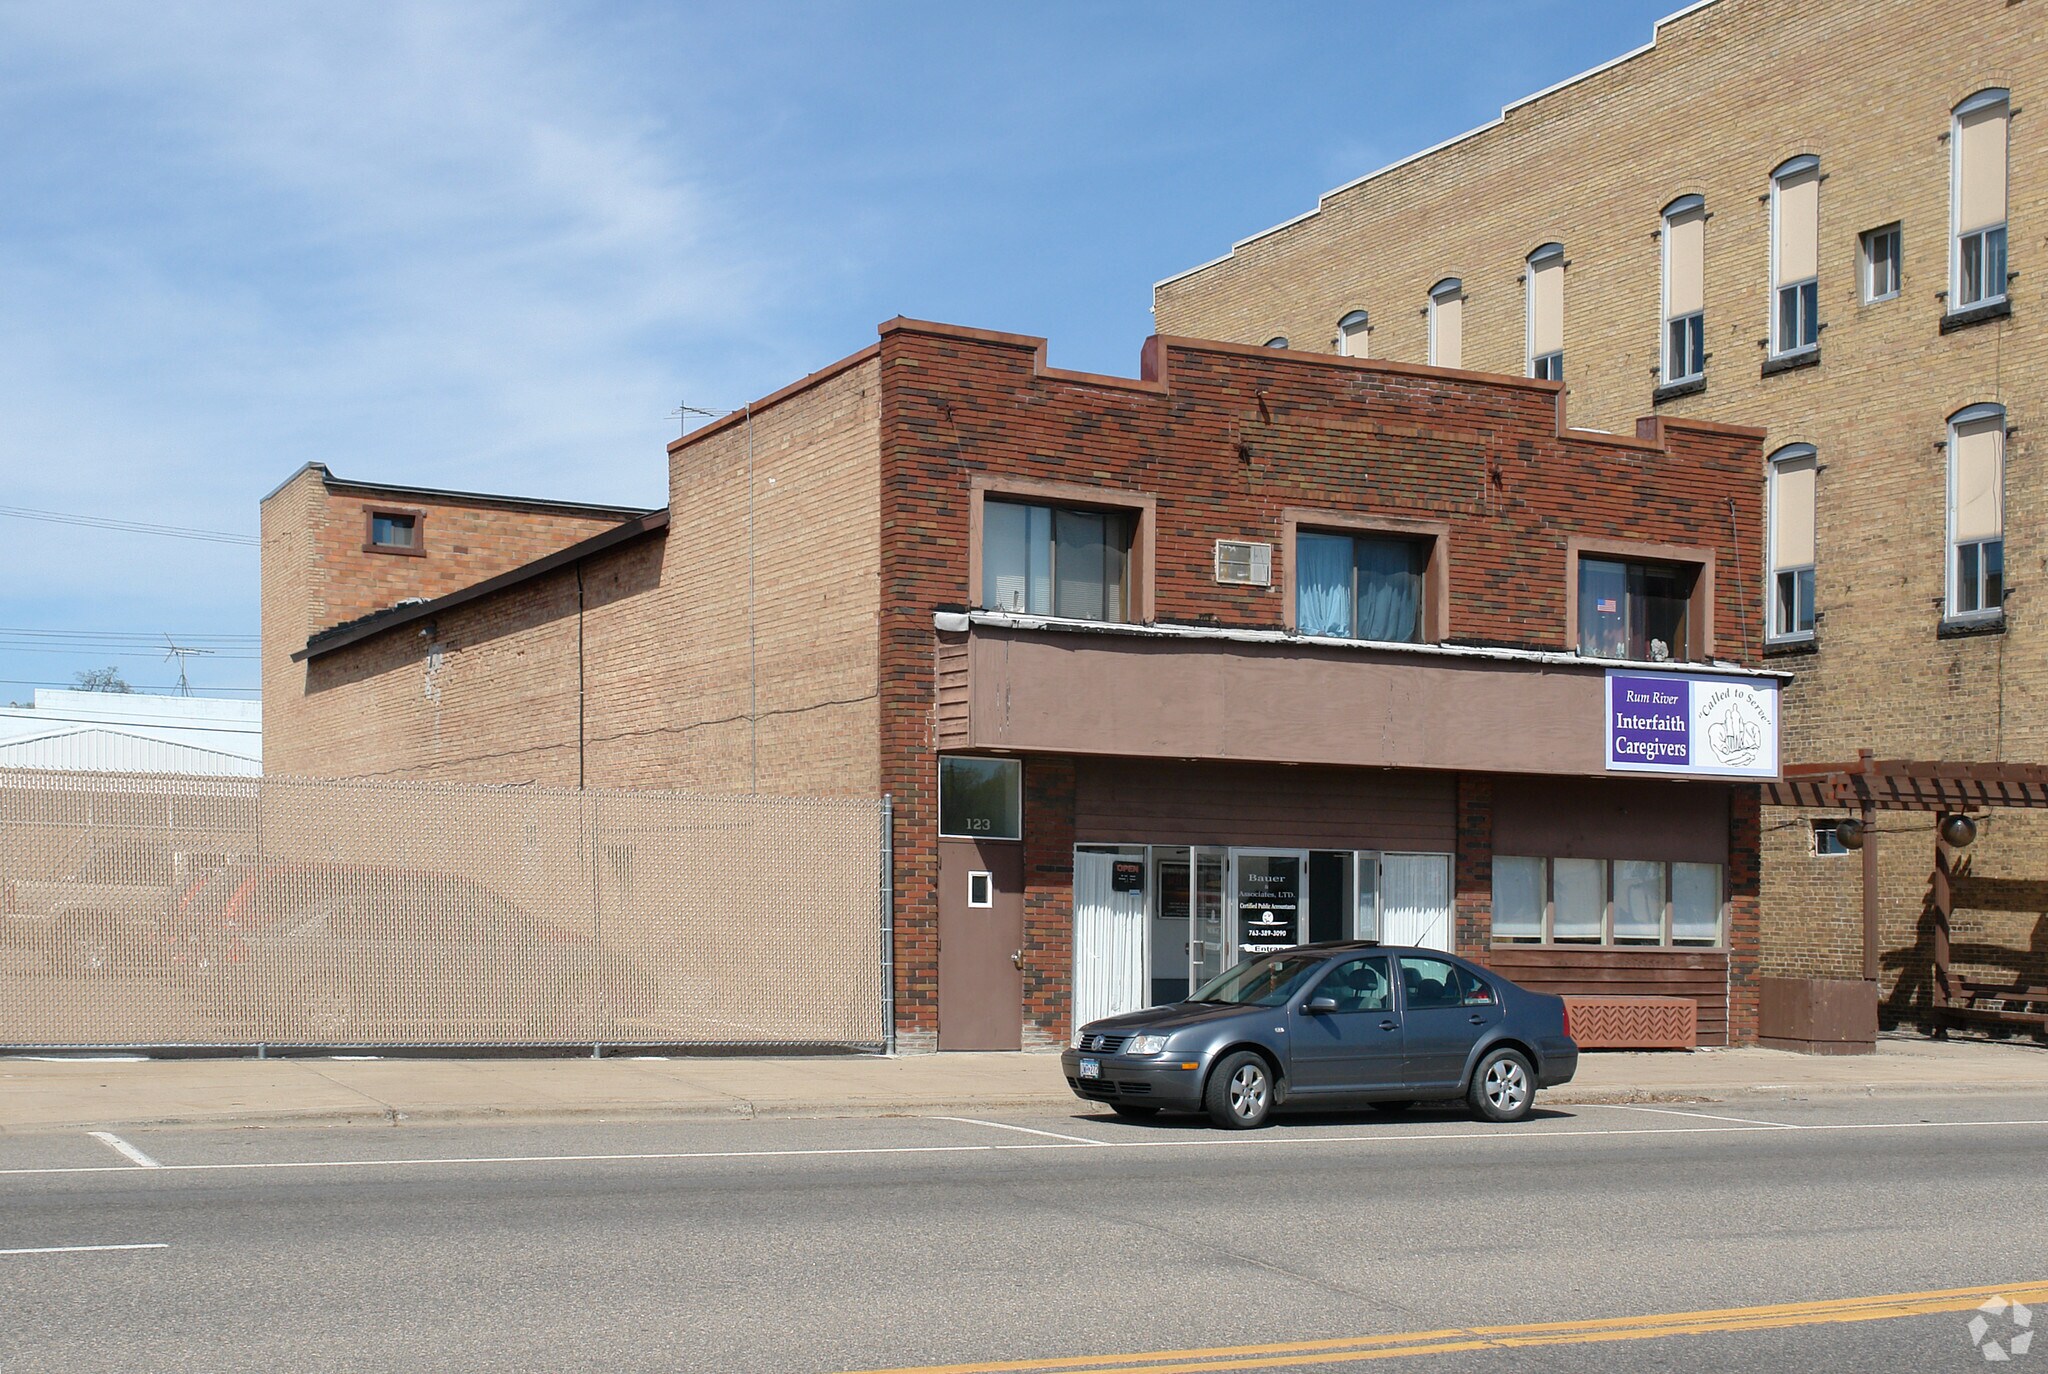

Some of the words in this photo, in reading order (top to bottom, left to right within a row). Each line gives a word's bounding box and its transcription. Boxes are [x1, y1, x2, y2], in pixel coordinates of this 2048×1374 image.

[1626, 690, 1650, 704] Rum
[1652, 692, 1679, 705] River
[1734, 688, 1744, 699] to
[1616, 712, 1686, 732] Interfaith
[1615, 736, 1687, 761] Caregivers
[966, 818, 991, 831] 123
[1116, 864, 1140, 873] OPEN
[1248, 873, 1286, 883] Bauer
[1239, 902, 1258, 910] Certified
[1258, 902, 1271, 910] Public
